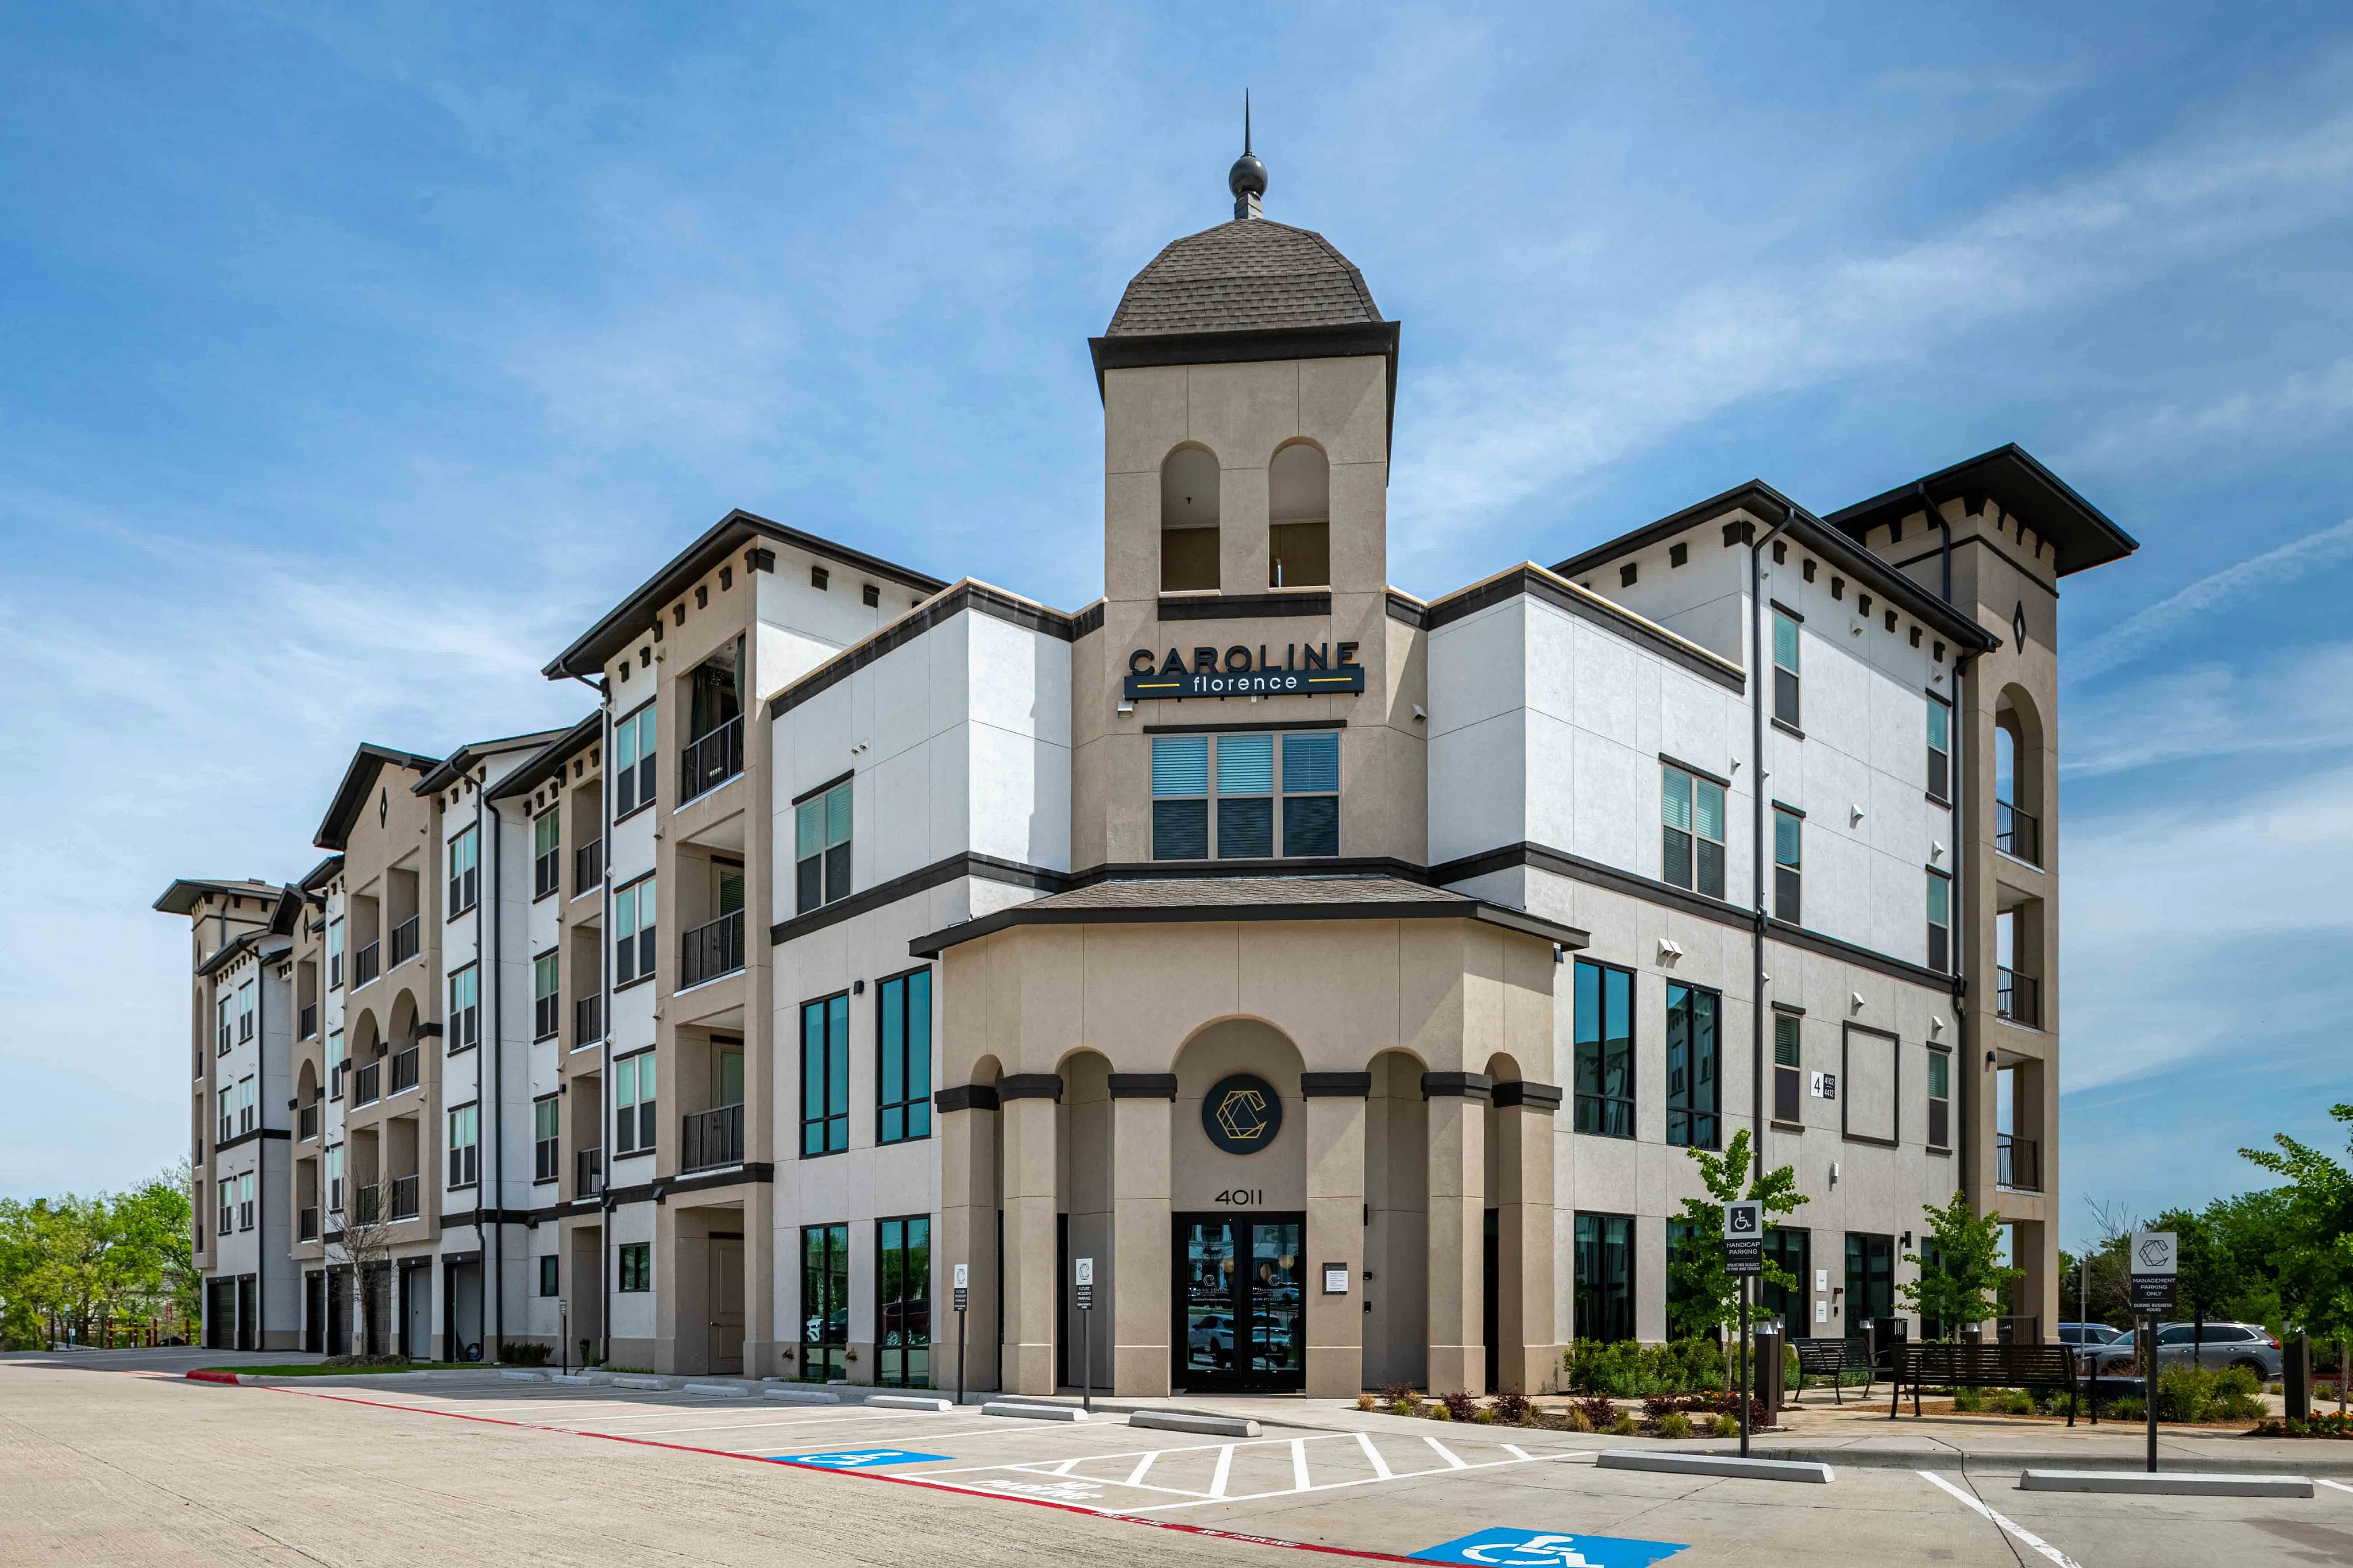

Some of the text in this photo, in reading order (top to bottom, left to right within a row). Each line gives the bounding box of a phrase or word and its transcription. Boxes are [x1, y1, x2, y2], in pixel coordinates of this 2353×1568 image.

[1129, 642, 1360, 676] CAROLINE
[1194, 676, 1298, 692] florence
[1814, 1077, 1820, 1094] 4
[1824, 1077, 1834, 1086] 4102
[1824, 1089, 1834, 1097] 4412
[1214, 1189, 1262, 1206] 4011
